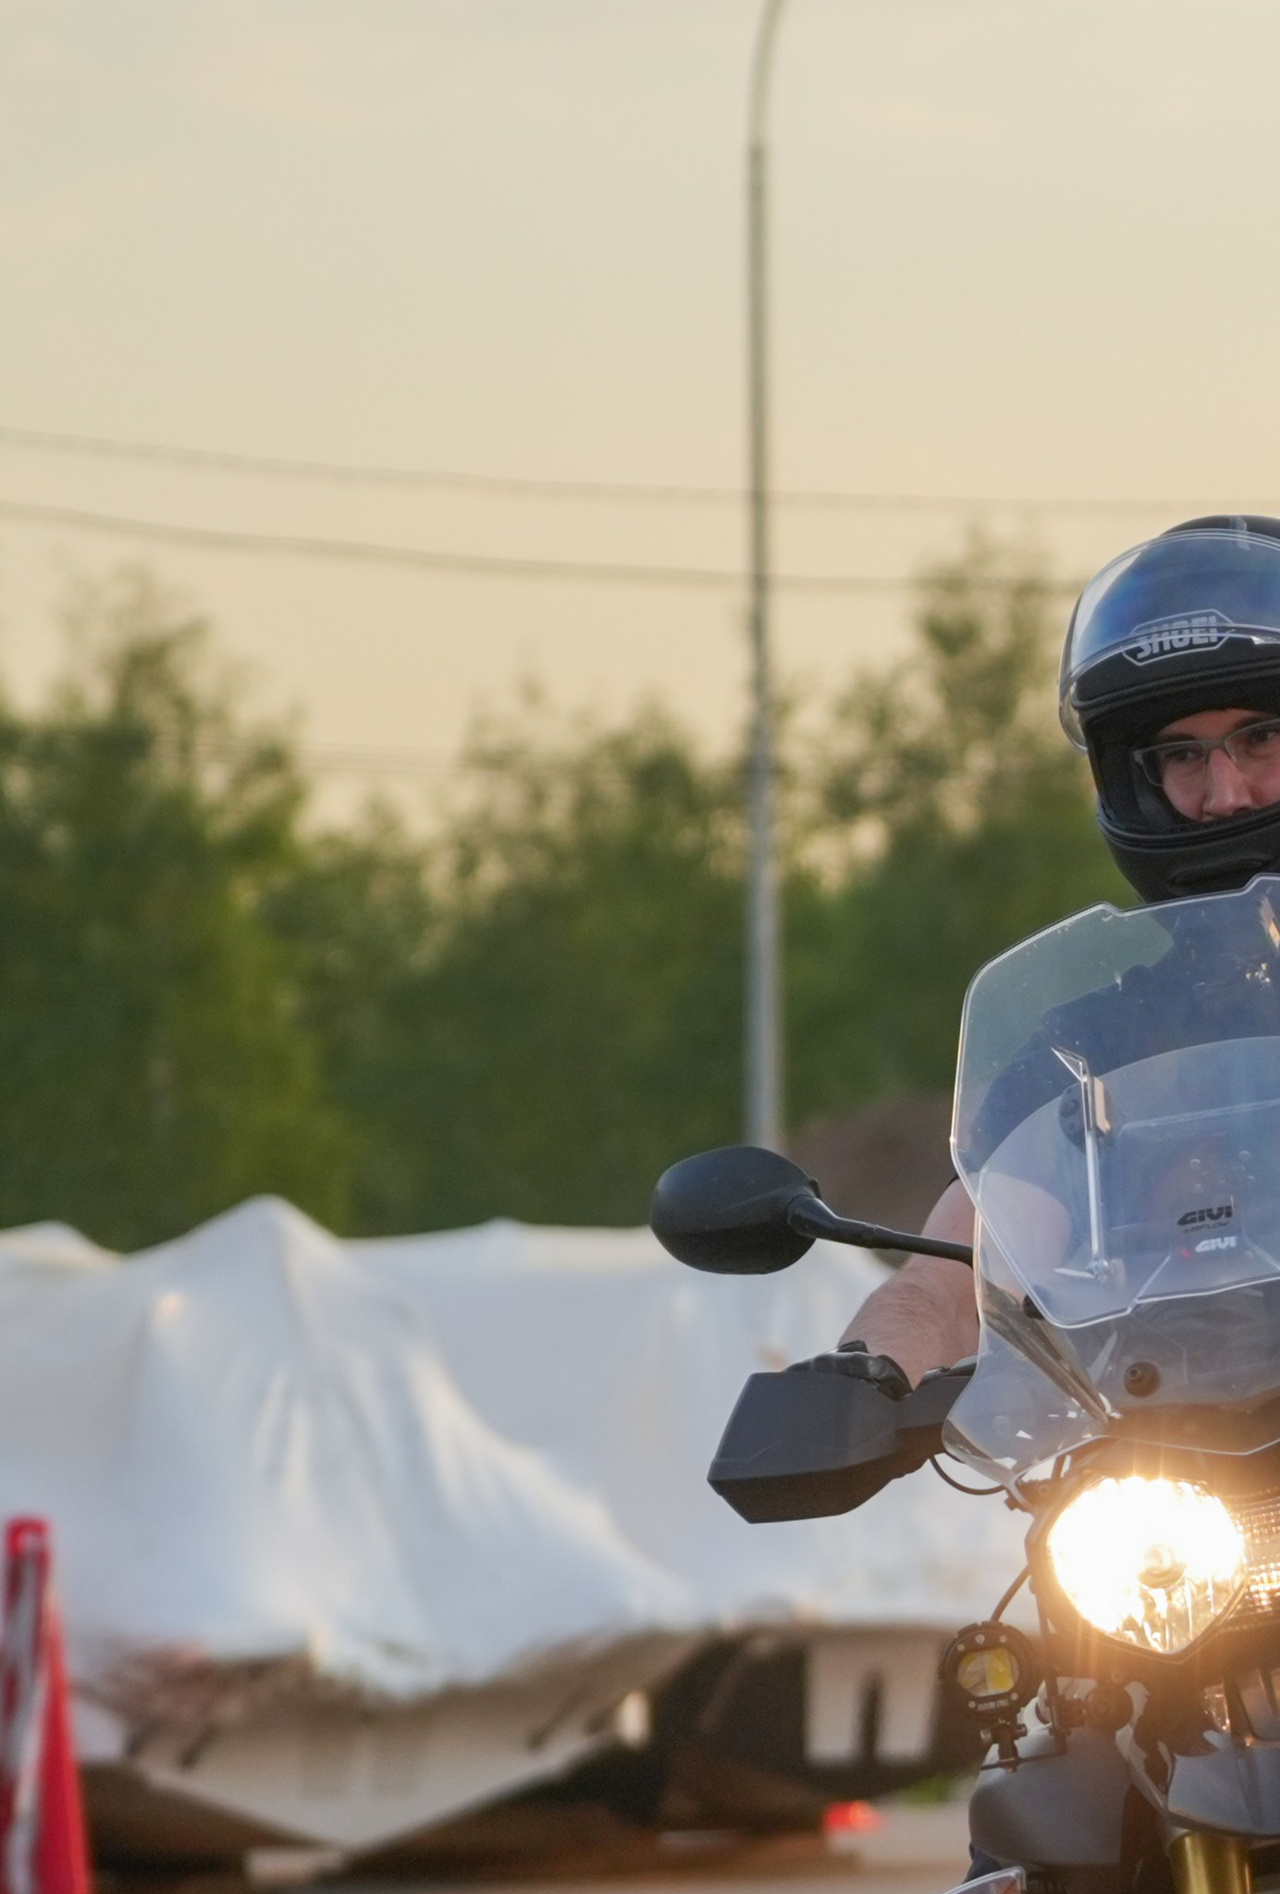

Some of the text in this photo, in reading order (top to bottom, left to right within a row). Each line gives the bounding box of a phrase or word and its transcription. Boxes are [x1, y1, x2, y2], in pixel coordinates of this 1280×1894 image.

[1136, 615, 1218, 659] SHOEI
[1177, 1205, 1233, 1226] GIVI
[1194, 1235, 1238, 1253] GIVI
